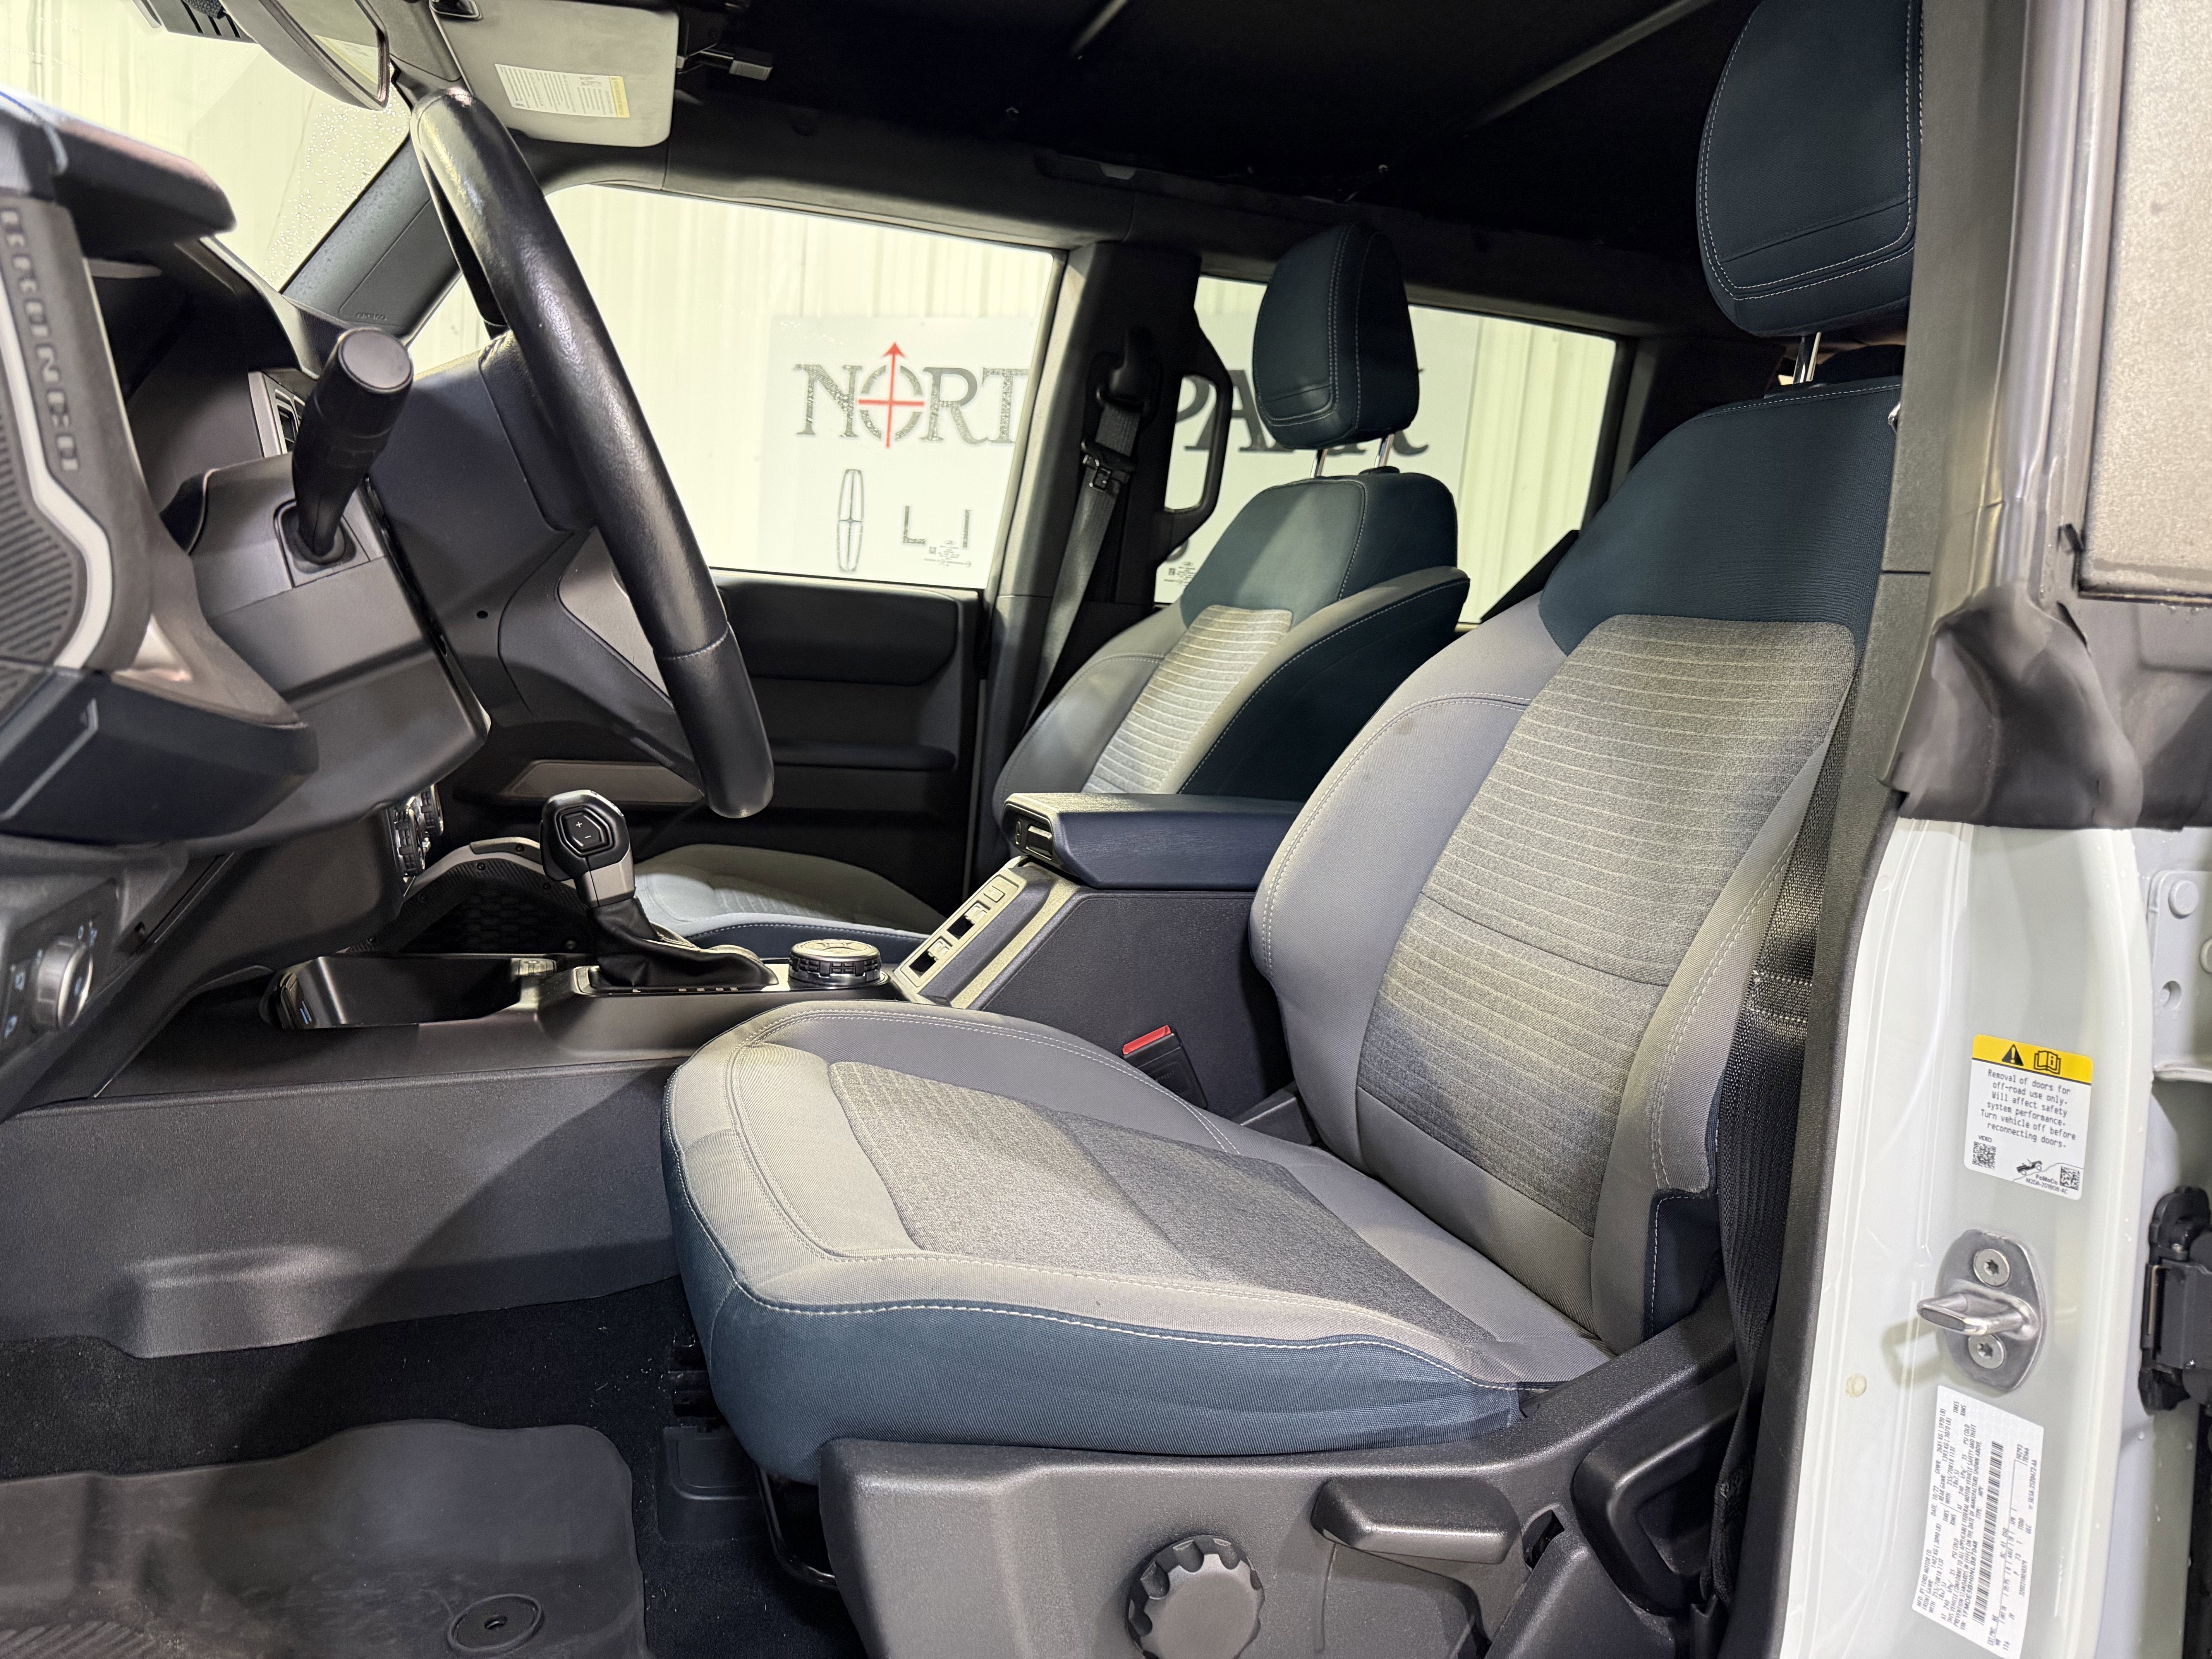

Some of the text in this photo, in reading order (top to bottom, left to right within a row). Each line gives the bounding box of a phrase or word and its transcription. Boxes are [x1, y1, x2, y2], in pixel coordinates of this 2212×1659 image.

[793, 364, 1030, 445] NORT
[1987, 1068, 2016, 1083] Removal
[2032, 1080, 2053, 1091] doors
[2058, 1085, 2071, 1094] for
[1992, 1081, 2067, 1106] off-road use only.
[1987, 1101, 2065, 1126] system performance.
[1992, 1091, 2067, 1118] Will affect safety
[1980, 1108, 2076, 1140] Turn vehicle off before
[1987, 1123, 2066, 1147] reconnecting doors.
[1953, 1596, 1963, 1627] PREVENTION
[1960, 1570, 1968, 1597] STANDARDS
[1966, 1539, 1972, 1547] ON
[1970, 1475, 1978, 1509] MANUFACTURE
[1922, 1593, 1930, 1610] FRONT
[1932, 1547, 1939, 1556] KG
[1953, 1567, 1962, 1593] CONFORMS
[1949, 1593, 1958, 1613] VEHICLE
